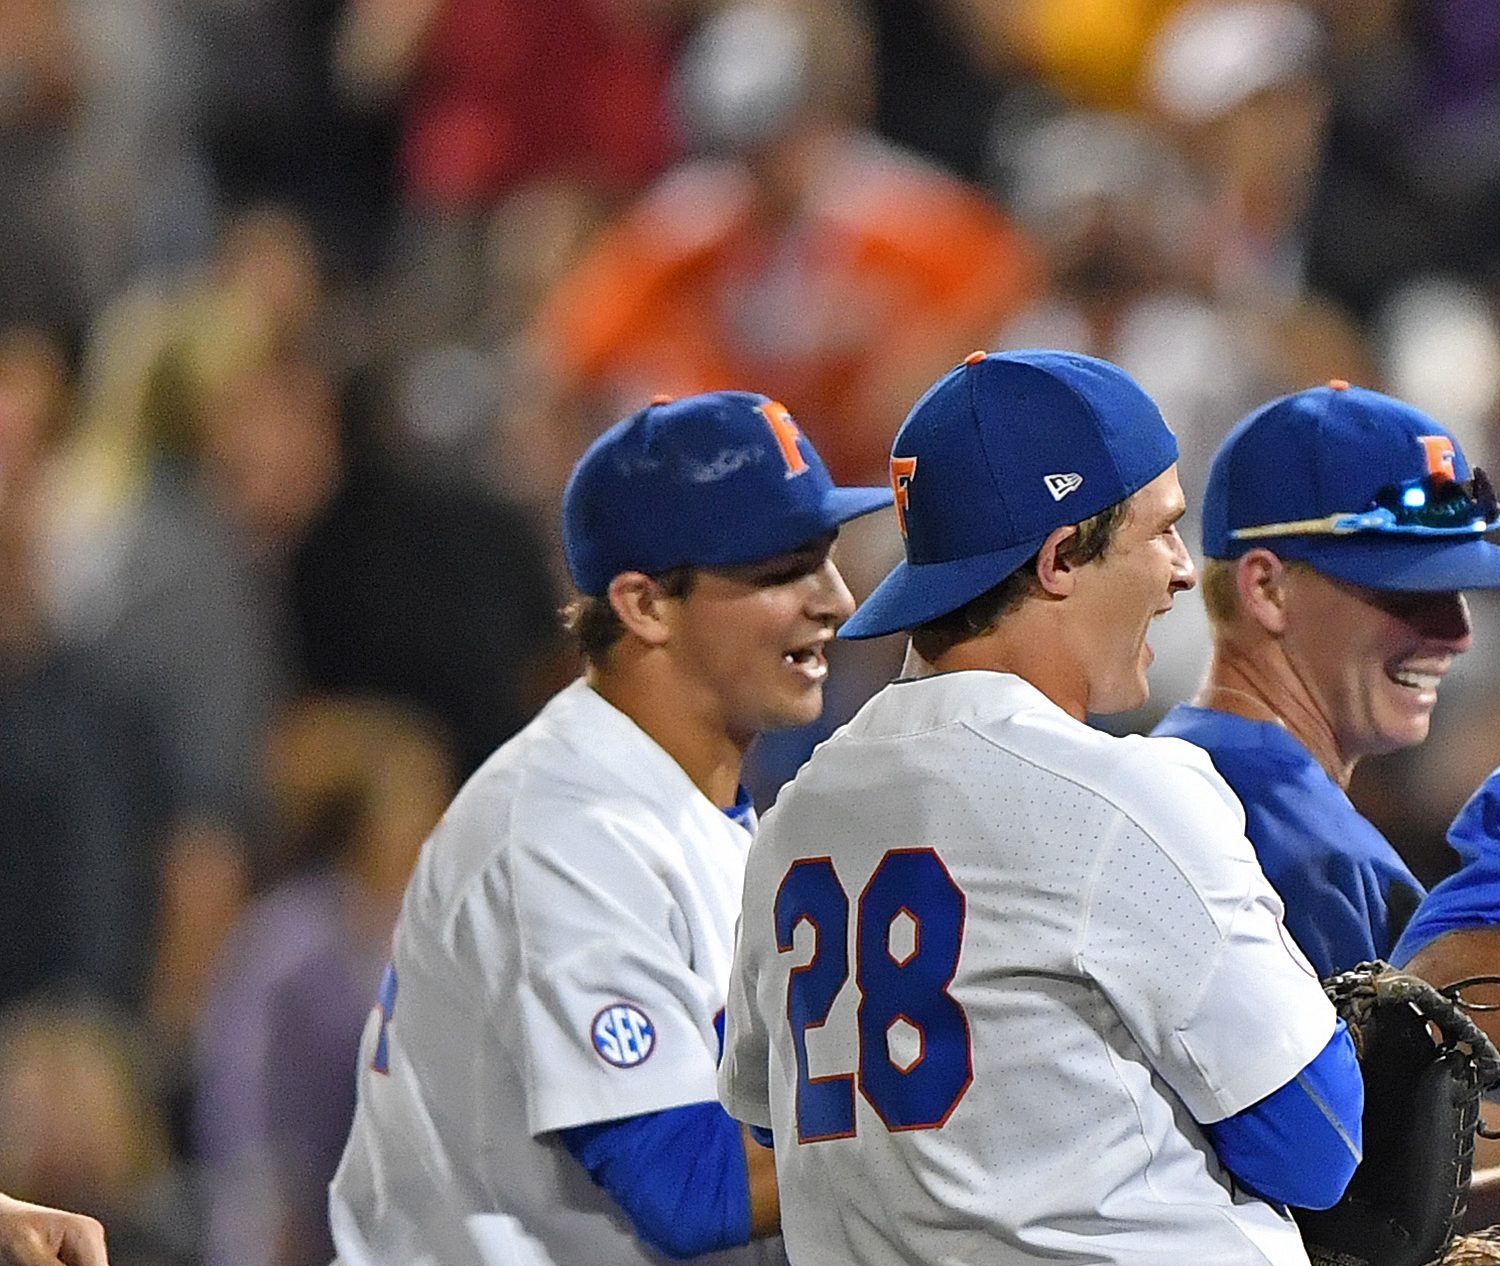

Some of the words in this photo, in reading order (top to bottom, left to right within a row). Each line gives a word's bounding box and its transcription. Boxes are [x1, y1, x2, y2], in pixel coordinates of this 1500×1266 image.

[752, 401, 809, 479] F
[889, 456, 917, 538] F
[594, 1007, 654, 1063] SEC
[773, 847, 973, 1144] 28
